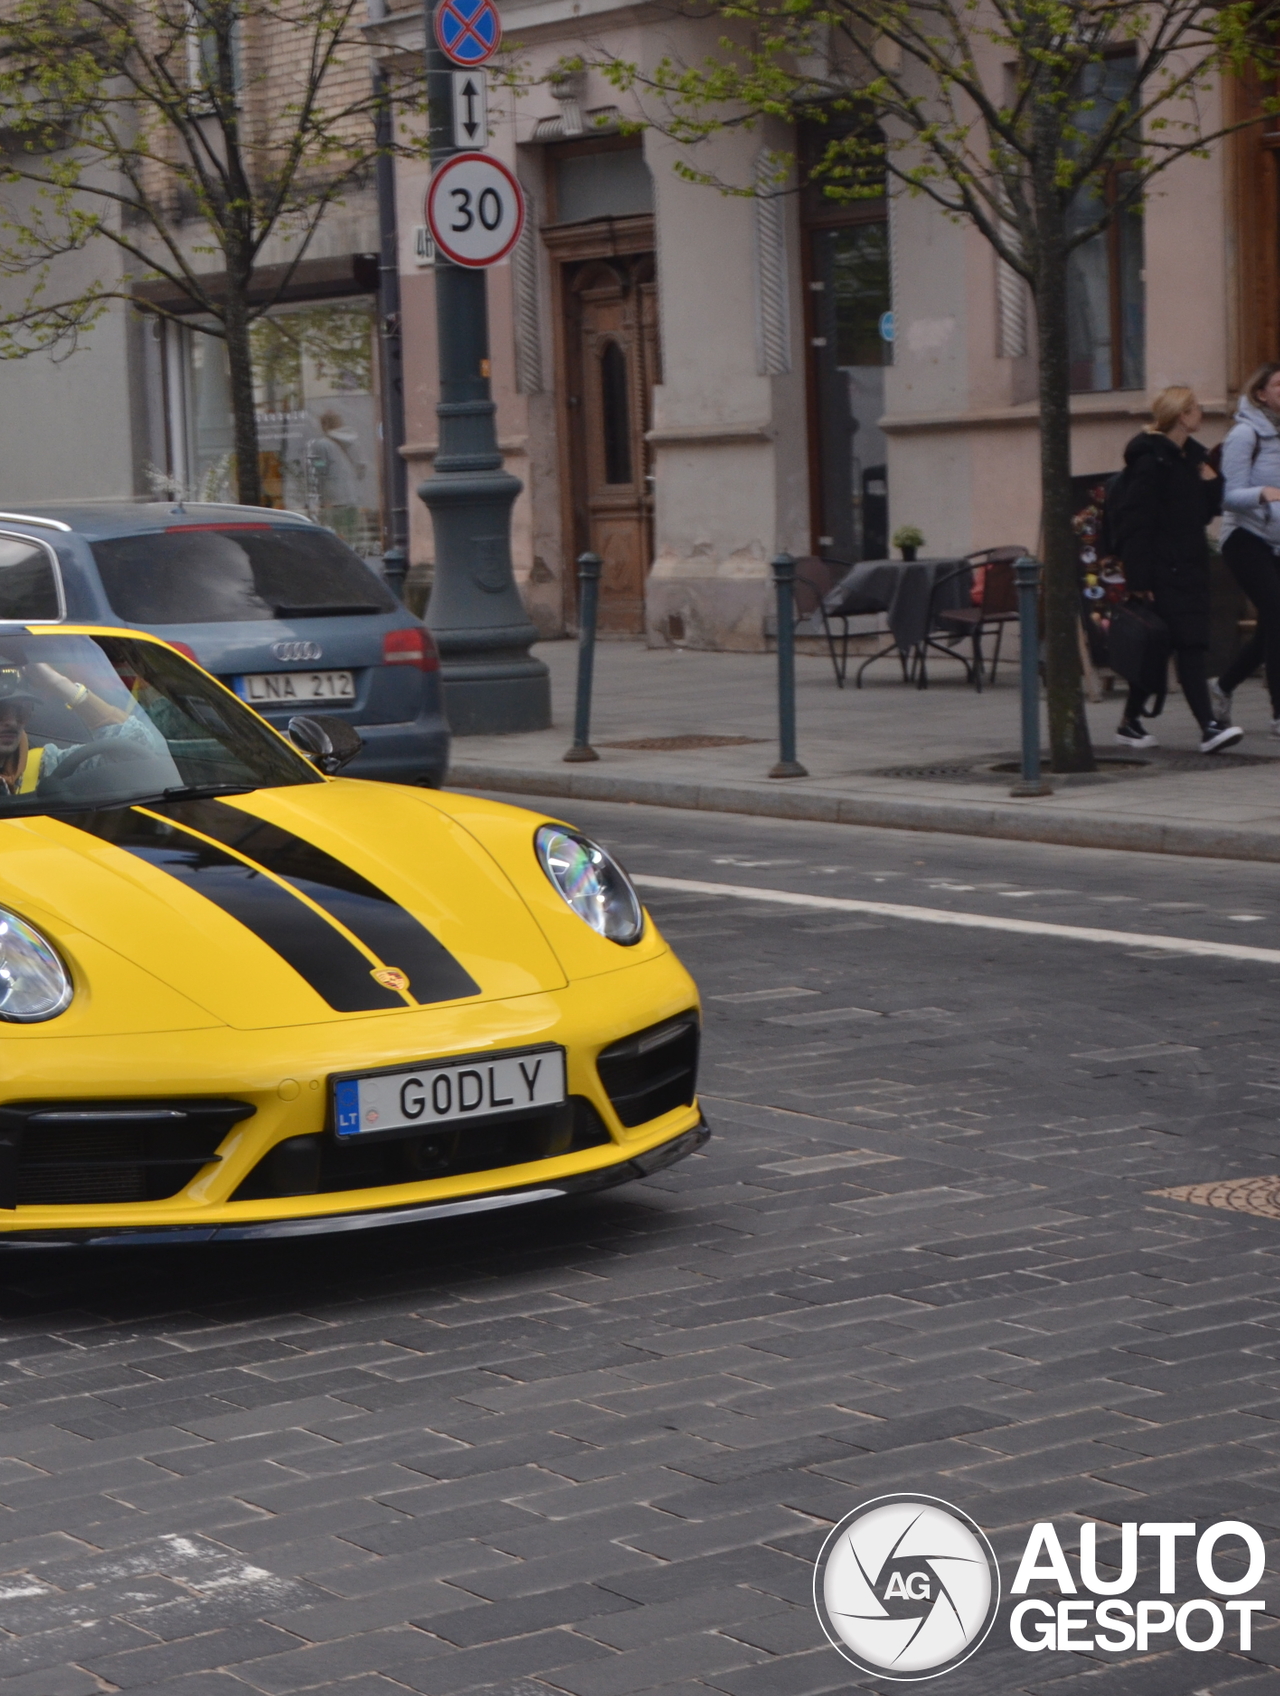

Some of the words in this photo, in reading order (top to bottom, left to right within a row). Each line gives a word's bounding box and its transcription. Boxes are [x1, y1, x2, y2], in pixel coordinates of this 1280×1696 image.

[451, 187, 503, 232] 30
[248, 676, 297, 699] LNA
[312, 674, 351, 697] 212
[339, 1113, 358, 1126] LT
